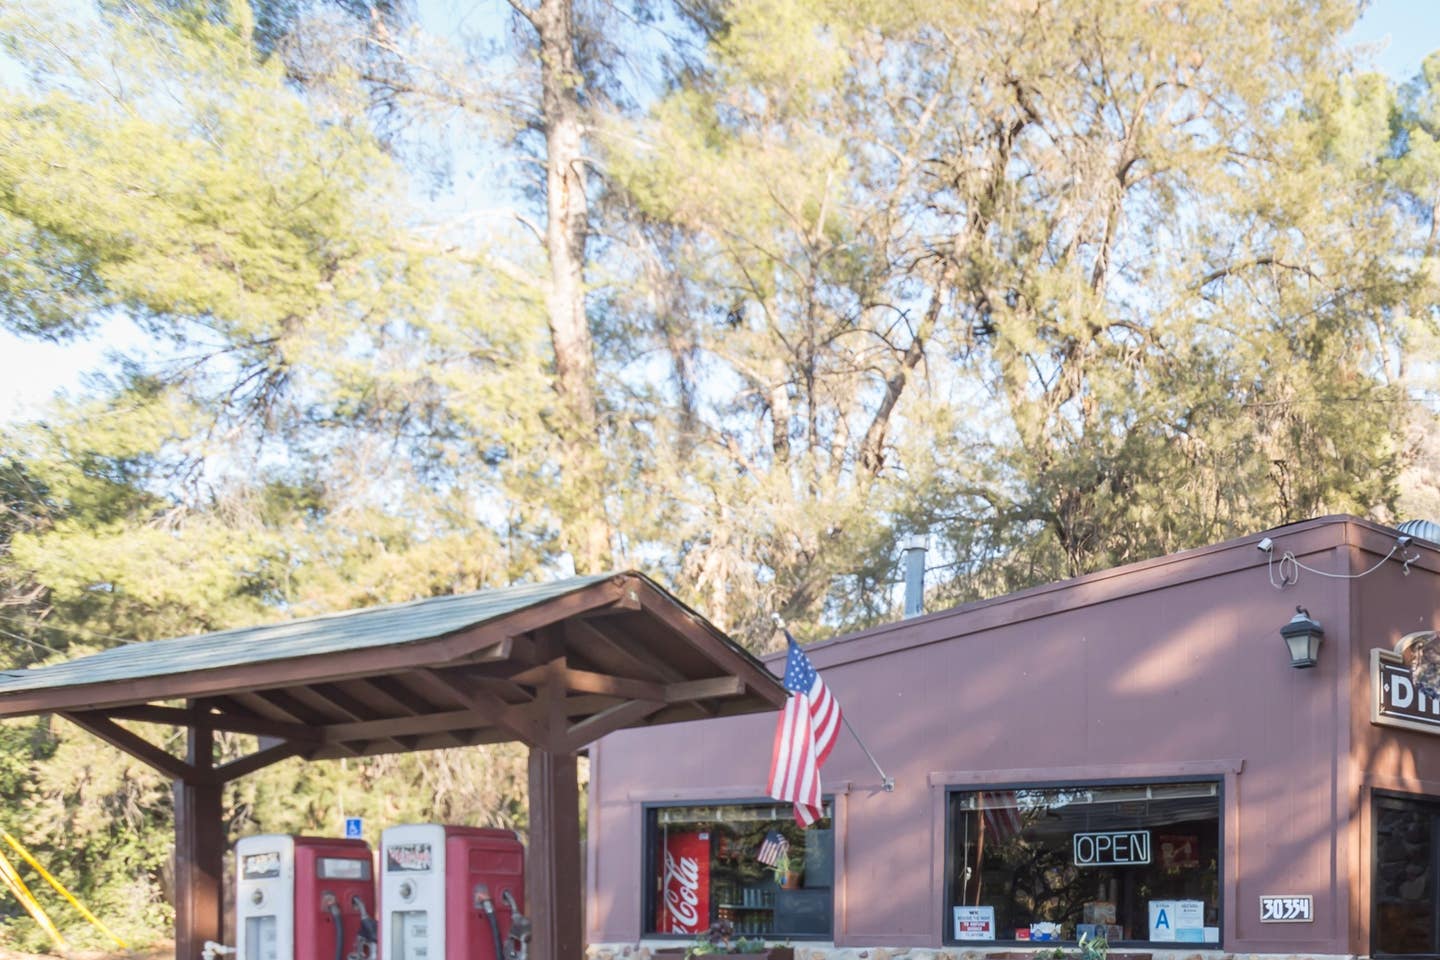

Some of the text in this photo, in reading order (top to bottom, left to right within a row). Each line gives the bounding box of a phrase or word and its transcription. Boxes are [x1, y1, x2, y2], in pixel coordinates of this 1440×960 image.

[1077, 833, 1147, 863] OPEN
[1155, 908, 1170, 929] A
[1263, 899, 1309, 919] 30354
